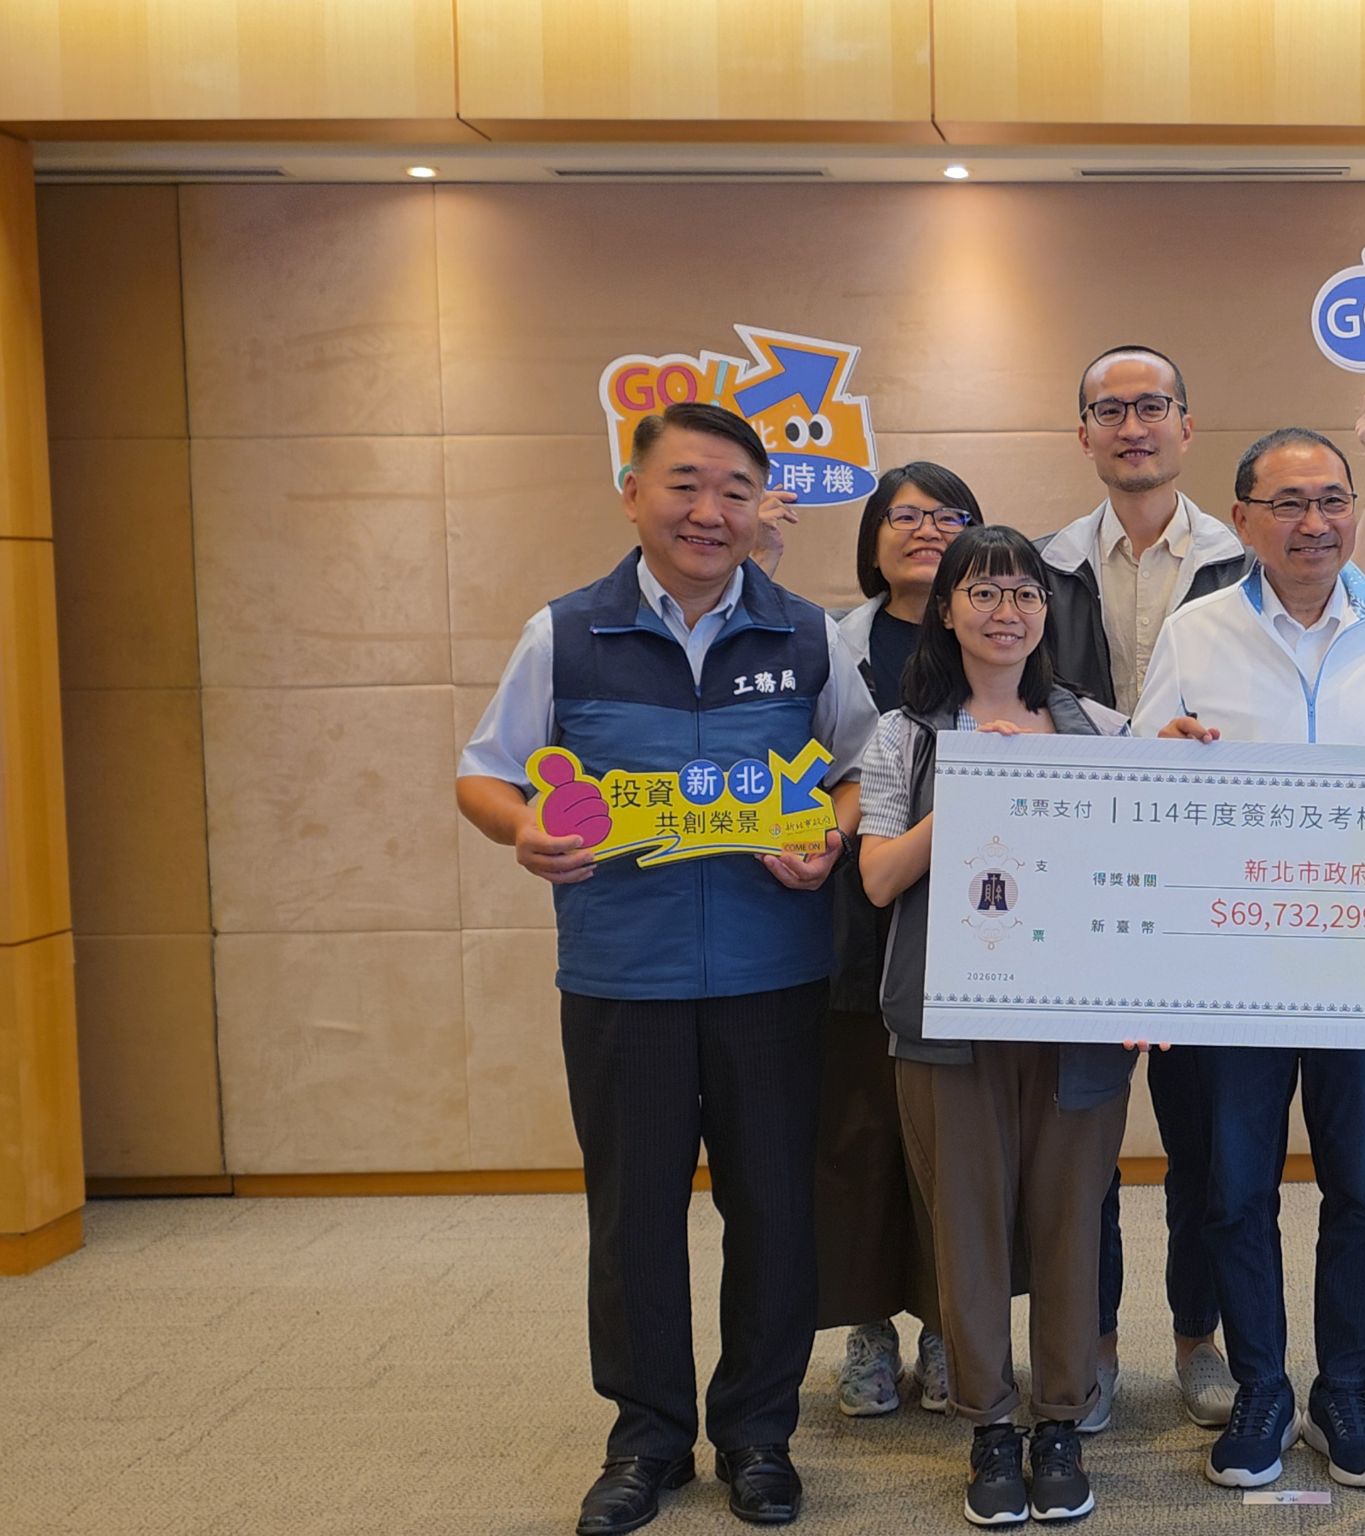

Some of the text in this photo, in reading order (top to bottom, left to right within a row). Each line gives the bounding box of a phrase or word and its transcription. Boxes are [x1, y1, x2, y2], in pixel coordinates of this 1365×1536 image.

[733, 668, 797, 696] 工務局
[611, 765, 765, 807] 投資新北
[1009, 798, 1093, 819] 憑票支付
[655, 810, 760, 836] 共創榮景
[1092, 871, 1158, 888] 得獎機關
[1091, 919, 1156, 934] 新臺幣
[967, 972, 1015, 981] 20260724
